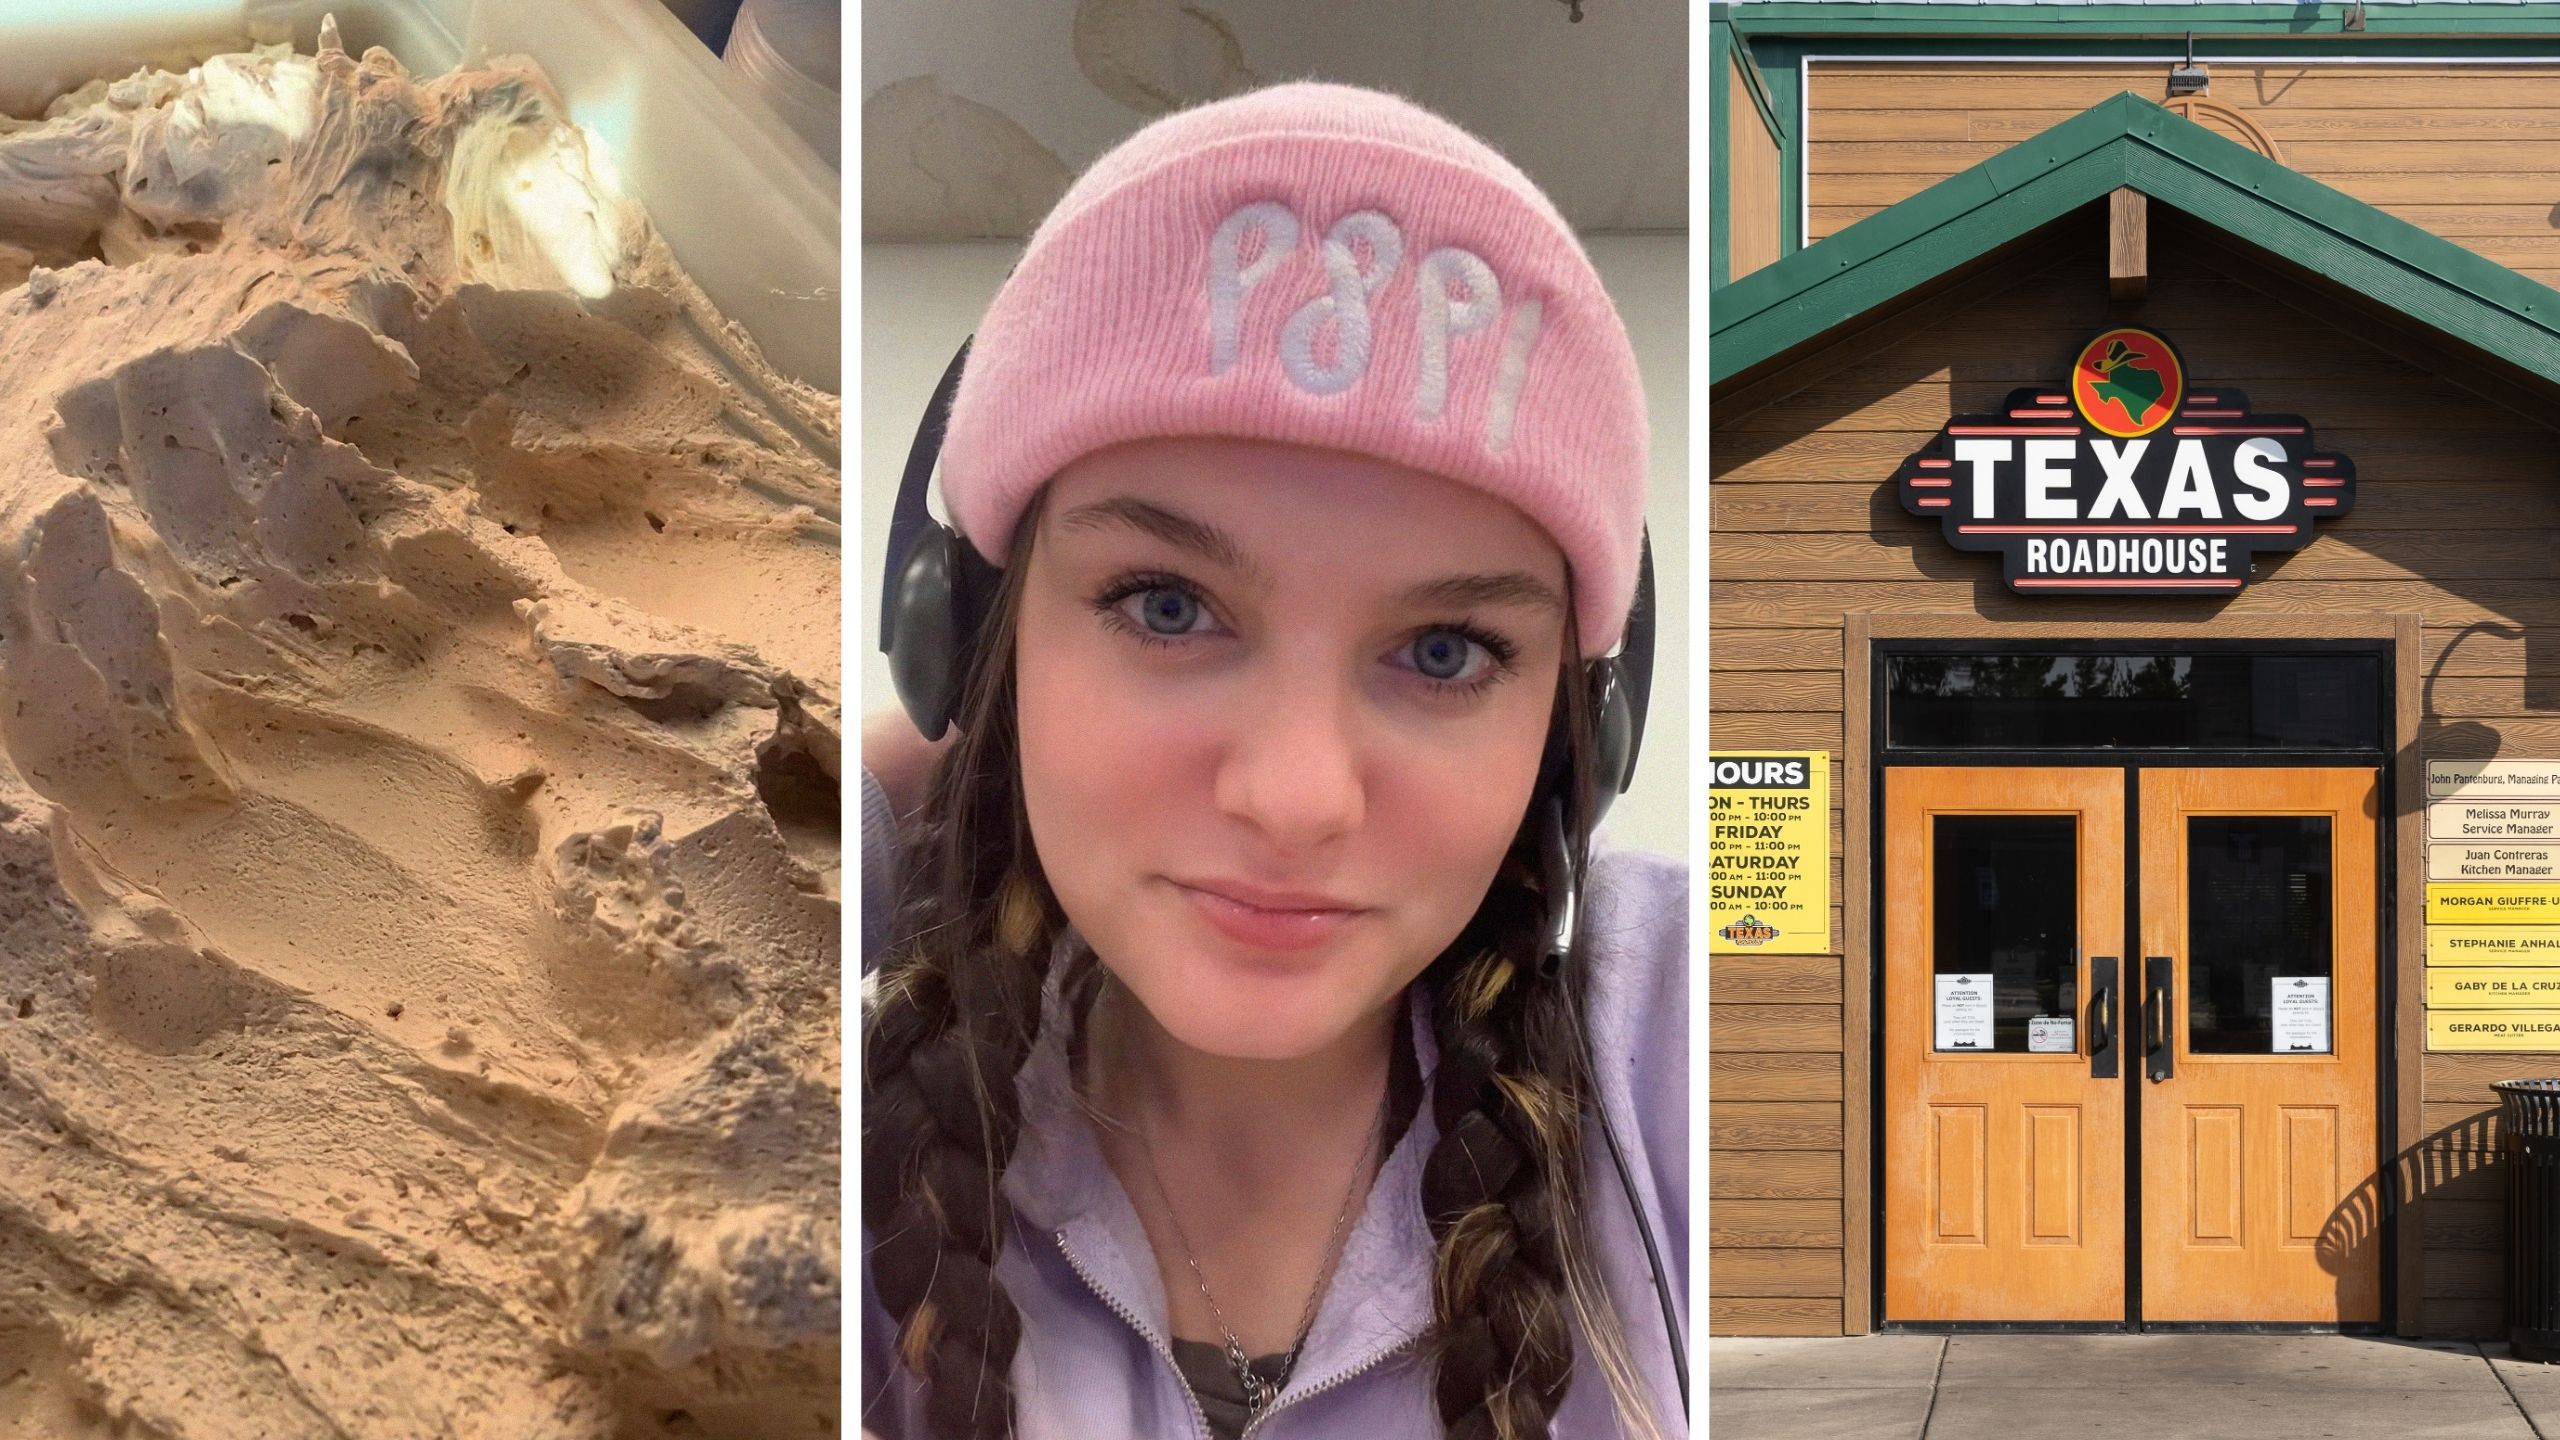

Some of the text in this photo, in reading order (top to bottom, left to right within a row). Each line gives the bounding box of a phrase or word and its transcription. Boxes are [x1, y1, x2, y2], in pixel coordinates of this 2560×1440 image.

[1954, 437, 2290, 521] TEXAS
[2027, 538, 2227, 573] ROADHOUSE
[1709, 761, 1804, 784] OURS
[2431, 774, 2451, 784] John
[2508, 774, 2549, 784] Managing
[1749, 796, 1810, 810] THURS
[1754, 812, 1787, 821] 10:00
[2466, 809, 2551, 820] Melissa Murray
[1715, 825, 1783, 839] FRIDAY
[2462, 824, 2554, 834] Service Manager
[1754, 841, 1785, 850] 11:00
[2465, 850, 2548, 860] Juan Contreras
[1709, 855, 1800, 869] ATURDAY
[2461, 865, 2553, 875] Kitchen Manager
[1755, 871, 1786, 881] 11:00
[1711, 885, 1787, 899] SUNDAY
[1754, 901, 1788, 910] 10:00
[2440, 896, 2560, 906] MORGAN GIUFFRE-U
[1727, 927, 1772, 939] TEXAS
[2449, 939, 2516, 948] STEPHANIE
[2455, 982, 2487, 991] GABY
[2492, 982, 2508, 990] DE
[2511, 982, 2528, 990] LA
[2449, 1023, 2508, 1032] GERARDO
